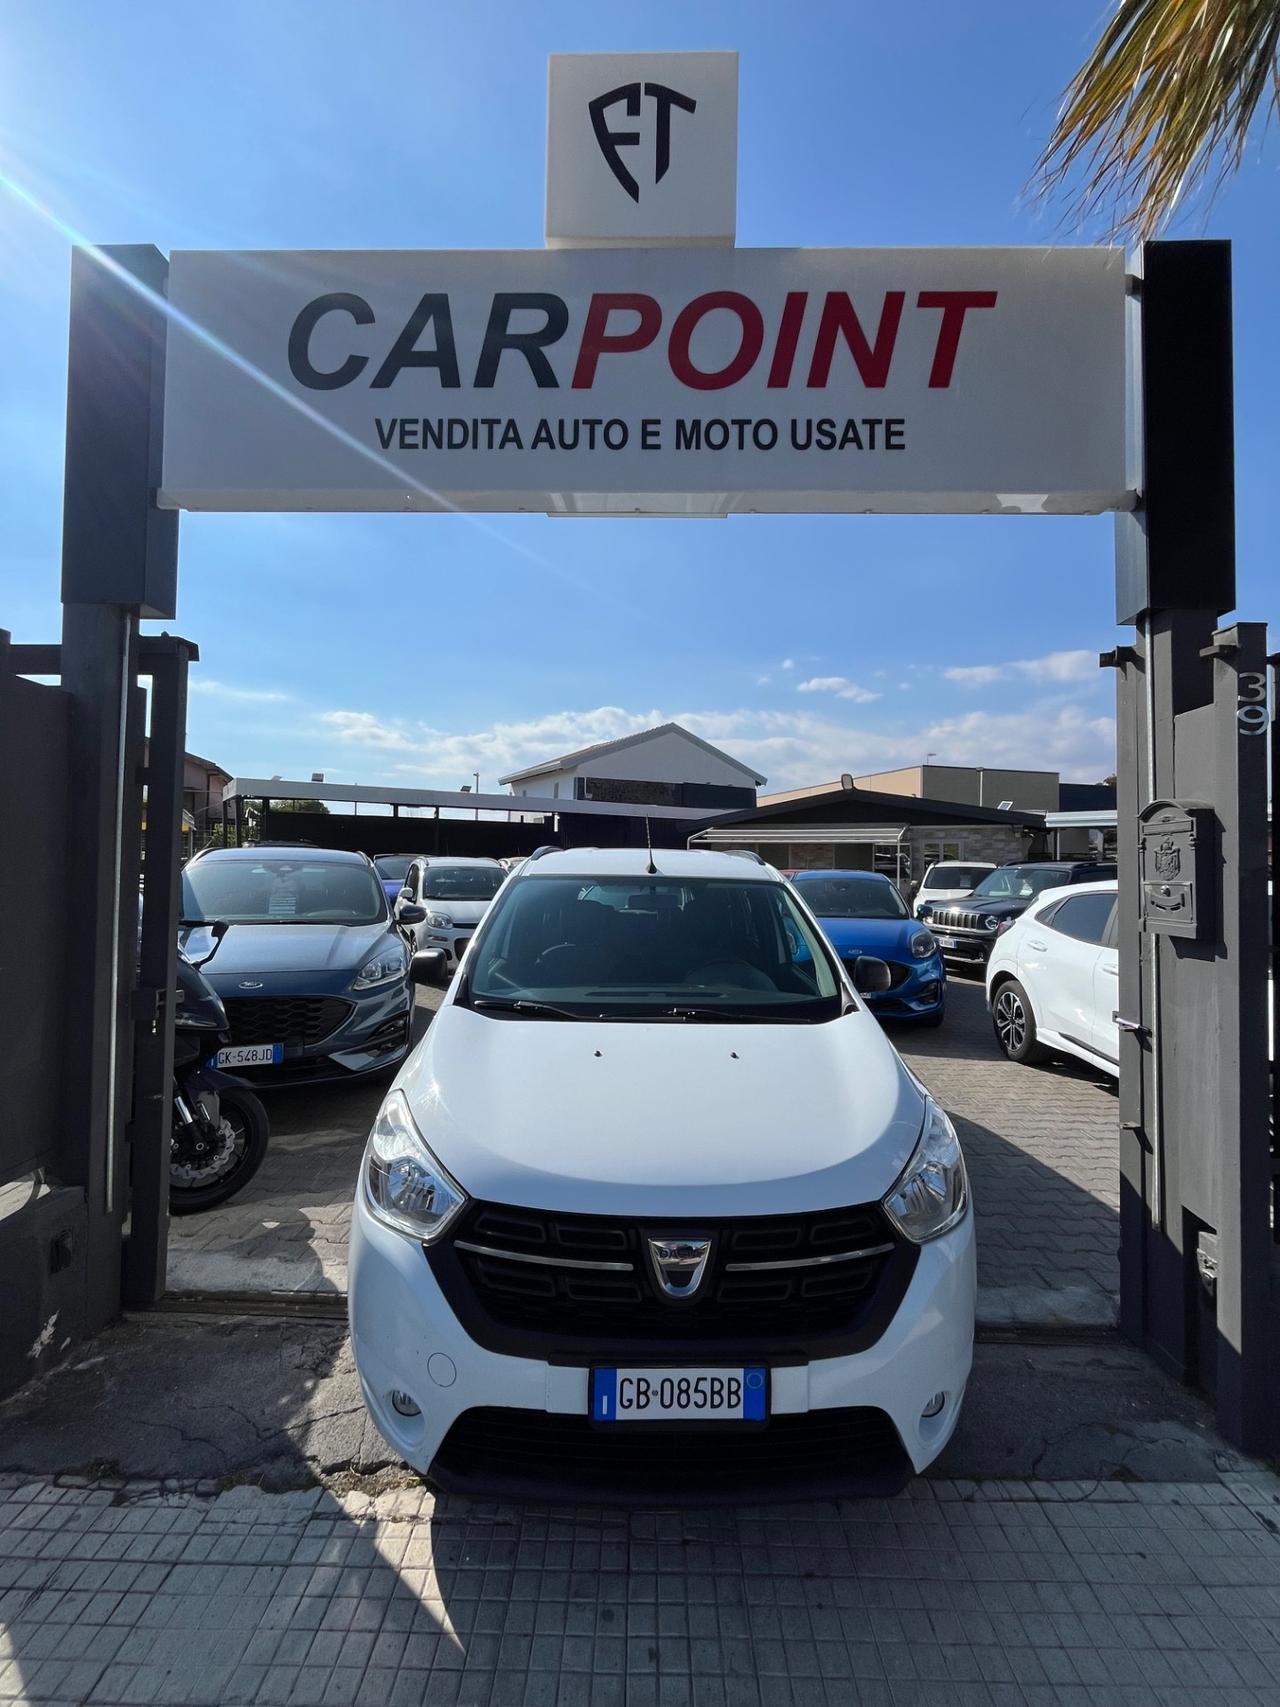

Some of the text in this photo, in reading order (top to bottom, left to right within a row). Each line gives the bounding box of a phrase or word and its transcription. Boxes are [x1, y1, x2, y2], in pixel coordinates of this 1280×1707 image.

[588, 82, 696, 203] FT
[288, 291, 998, 390] CARPOINT
[375, 418, 906, 451] VENDITA AUTO E MOTO USATE
[1237, 671, 1270, 736] 39
